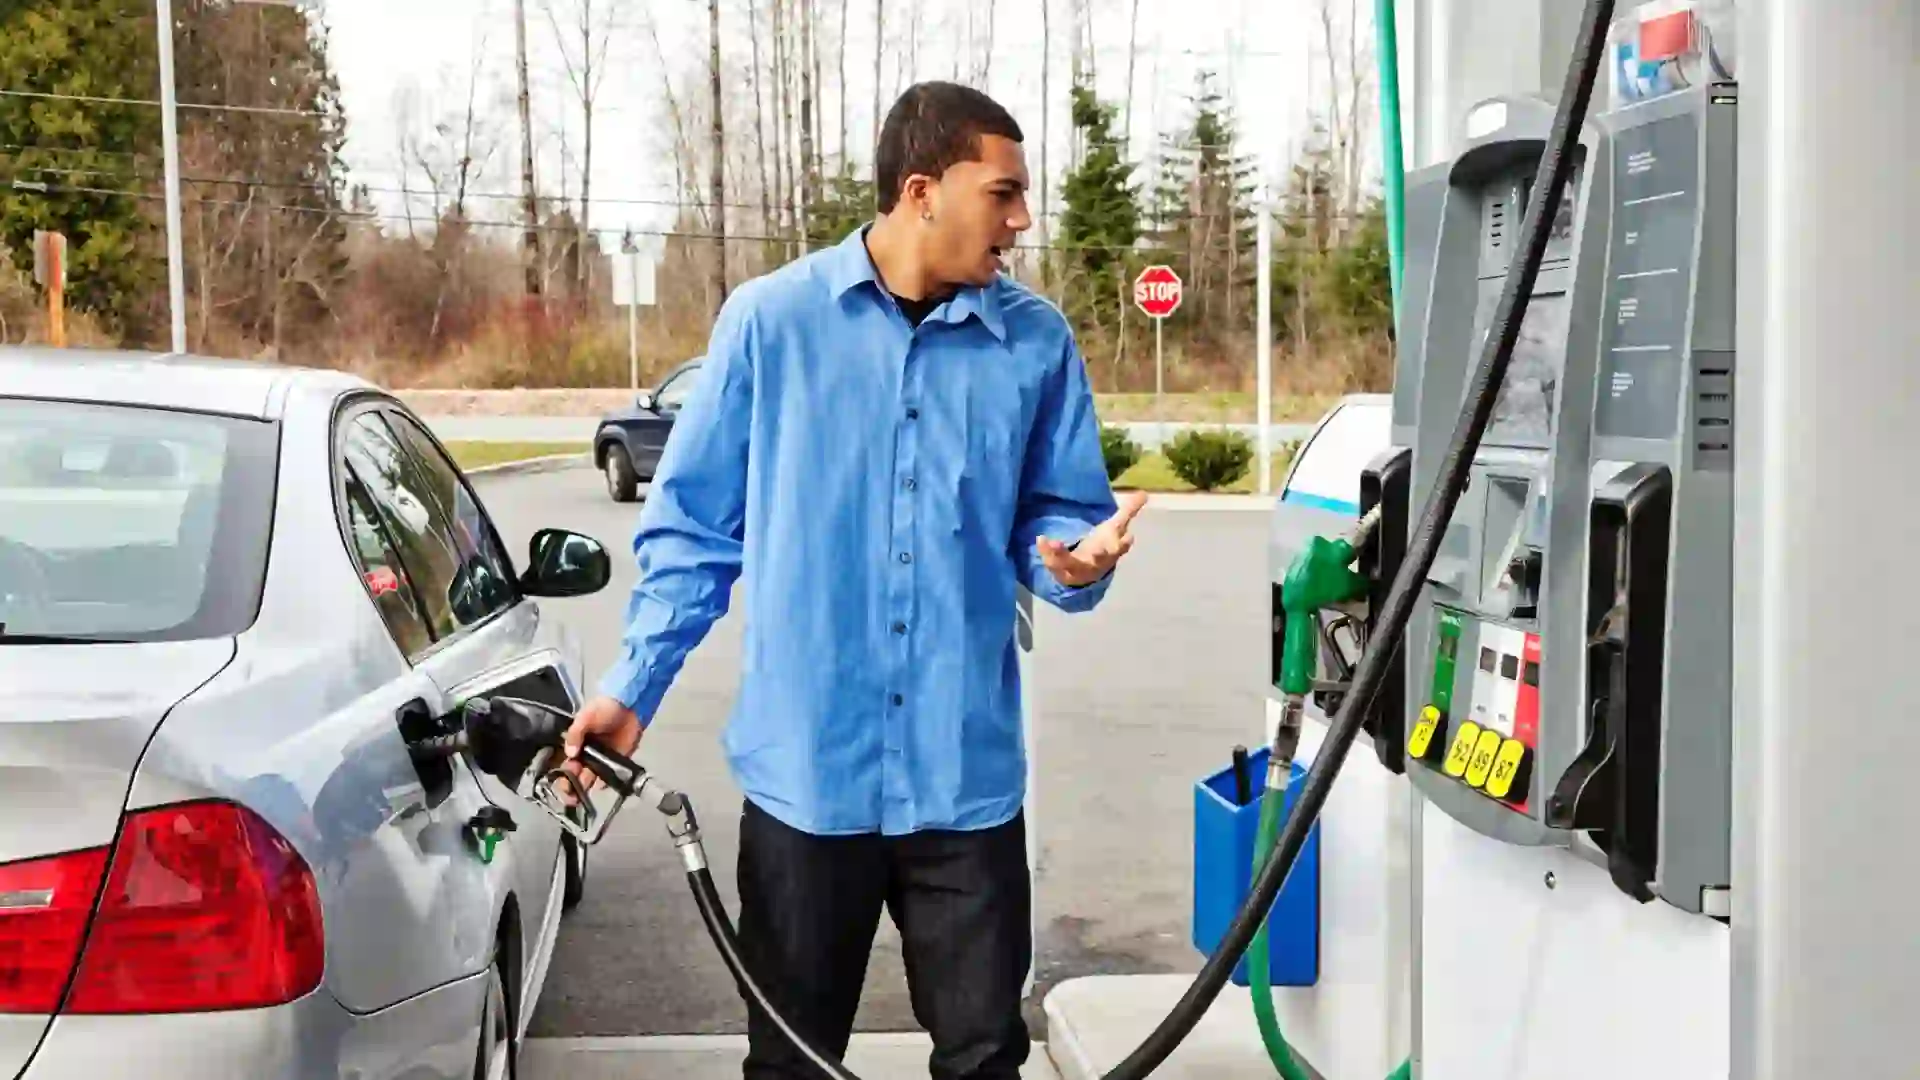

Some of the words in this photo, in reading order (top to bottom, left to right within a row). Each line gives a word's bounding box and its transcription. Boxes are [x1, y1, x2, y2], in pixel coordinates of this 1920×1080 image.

[1137, 282, 1178, 302] STOP
[1452, 741, 1470, 762] 92
[1474, 751, 1490, 772] 89
[1495, 760, 1514, 780] 87
